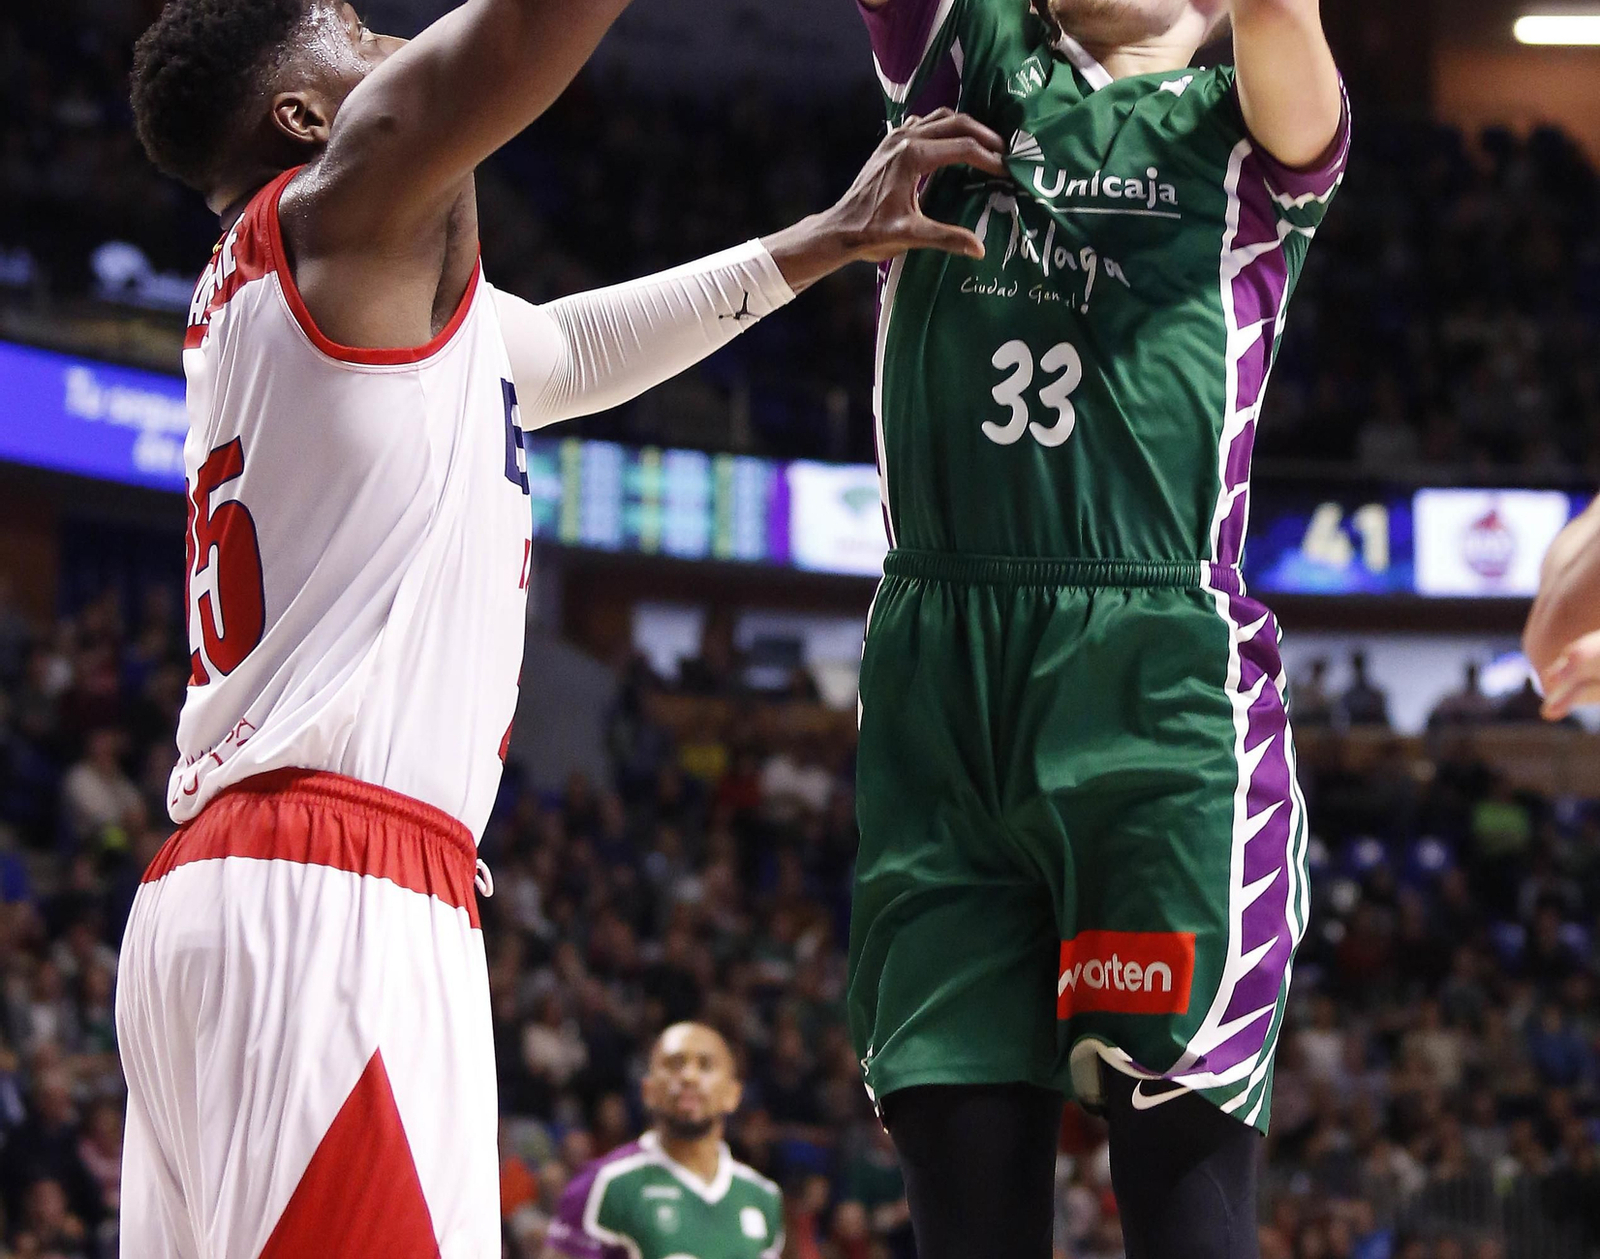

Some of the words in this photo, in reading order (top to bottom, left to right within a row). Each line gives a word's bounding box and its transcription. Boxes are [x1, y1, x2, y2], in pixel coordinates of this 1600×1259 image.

[1033, 166, 1179, 209] Unicaja
[961, 276, 1019, 297] Ciudad
[981, 339, 1082, 447] 33
[186, 435, 266, 686] 5
